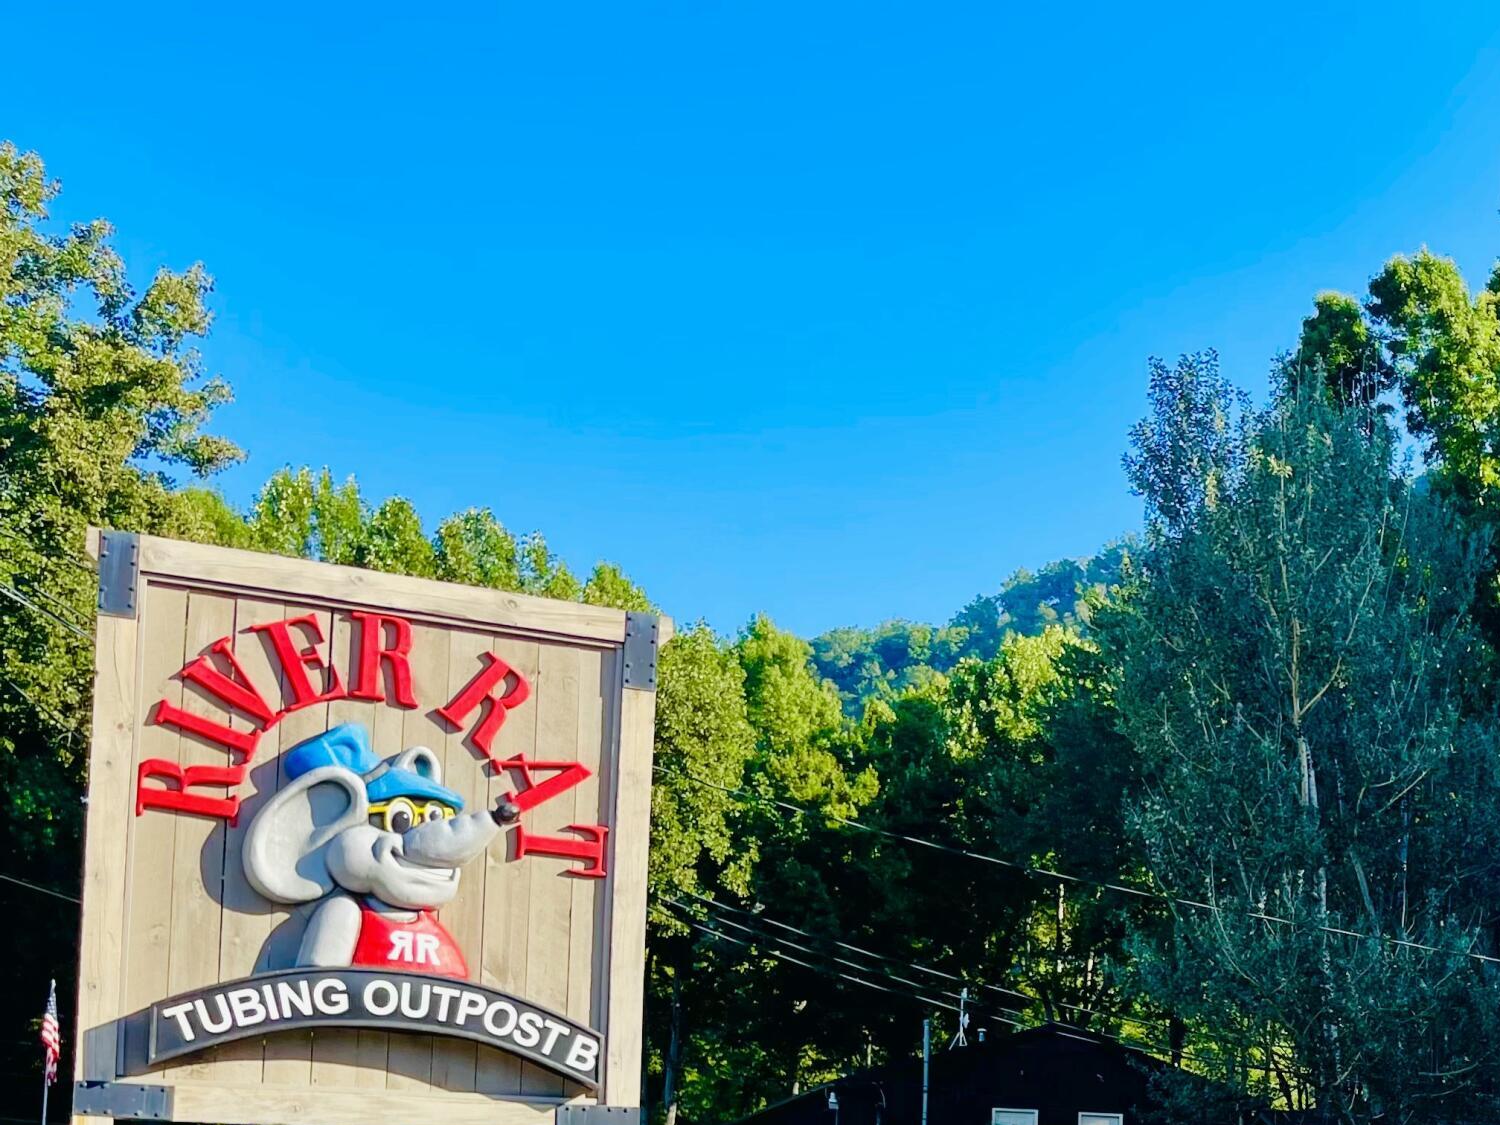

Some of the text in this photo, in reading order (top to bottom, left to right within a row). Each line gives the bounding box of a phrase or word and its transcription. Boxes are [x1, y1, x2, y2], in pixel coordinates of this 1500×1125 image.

[136, 610, 609, 877] RIVER RAT
[163, 978, 600, 1072] TUBING OUTPOST B
